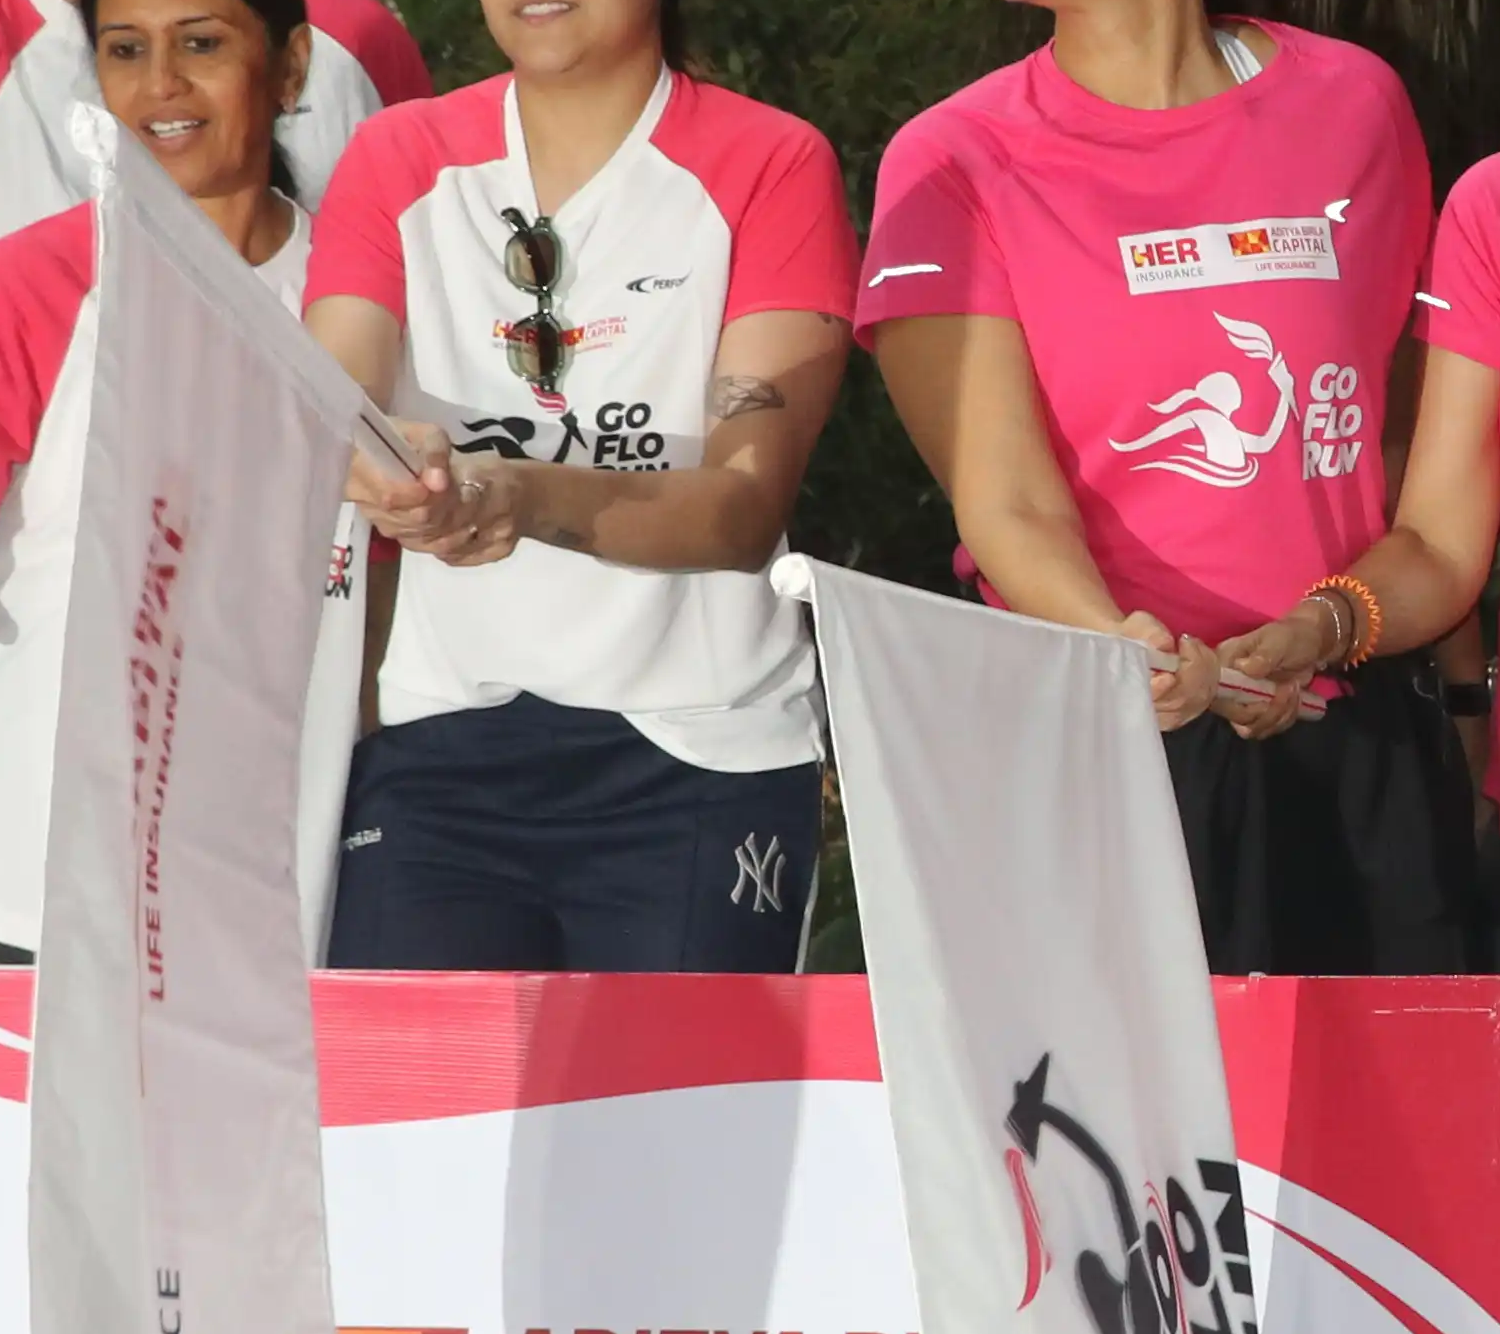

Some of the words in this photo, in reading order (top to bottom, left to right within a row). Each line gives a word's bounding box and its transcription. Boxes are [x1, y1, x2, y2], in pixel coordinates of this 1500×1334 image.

[1130, 237, 1201, 269] HER
[1273, 238, 1328, 254] CAPITAL
[1136, 266, 1204, 283] INSURANCE
[1256, 262, 1273, 272] LIFE
[1275, 260, 1317, 271] INSURANCE
[1310, 362, 1357, 401] GO
[596, 402, 651, 432] GO
[1303, 402, 1362, 440] FLO
[594, 431, 664, 464] FLO
[1303, 441, 1363, 481] RUN
[148, 906, 165, 1002] LIFE
